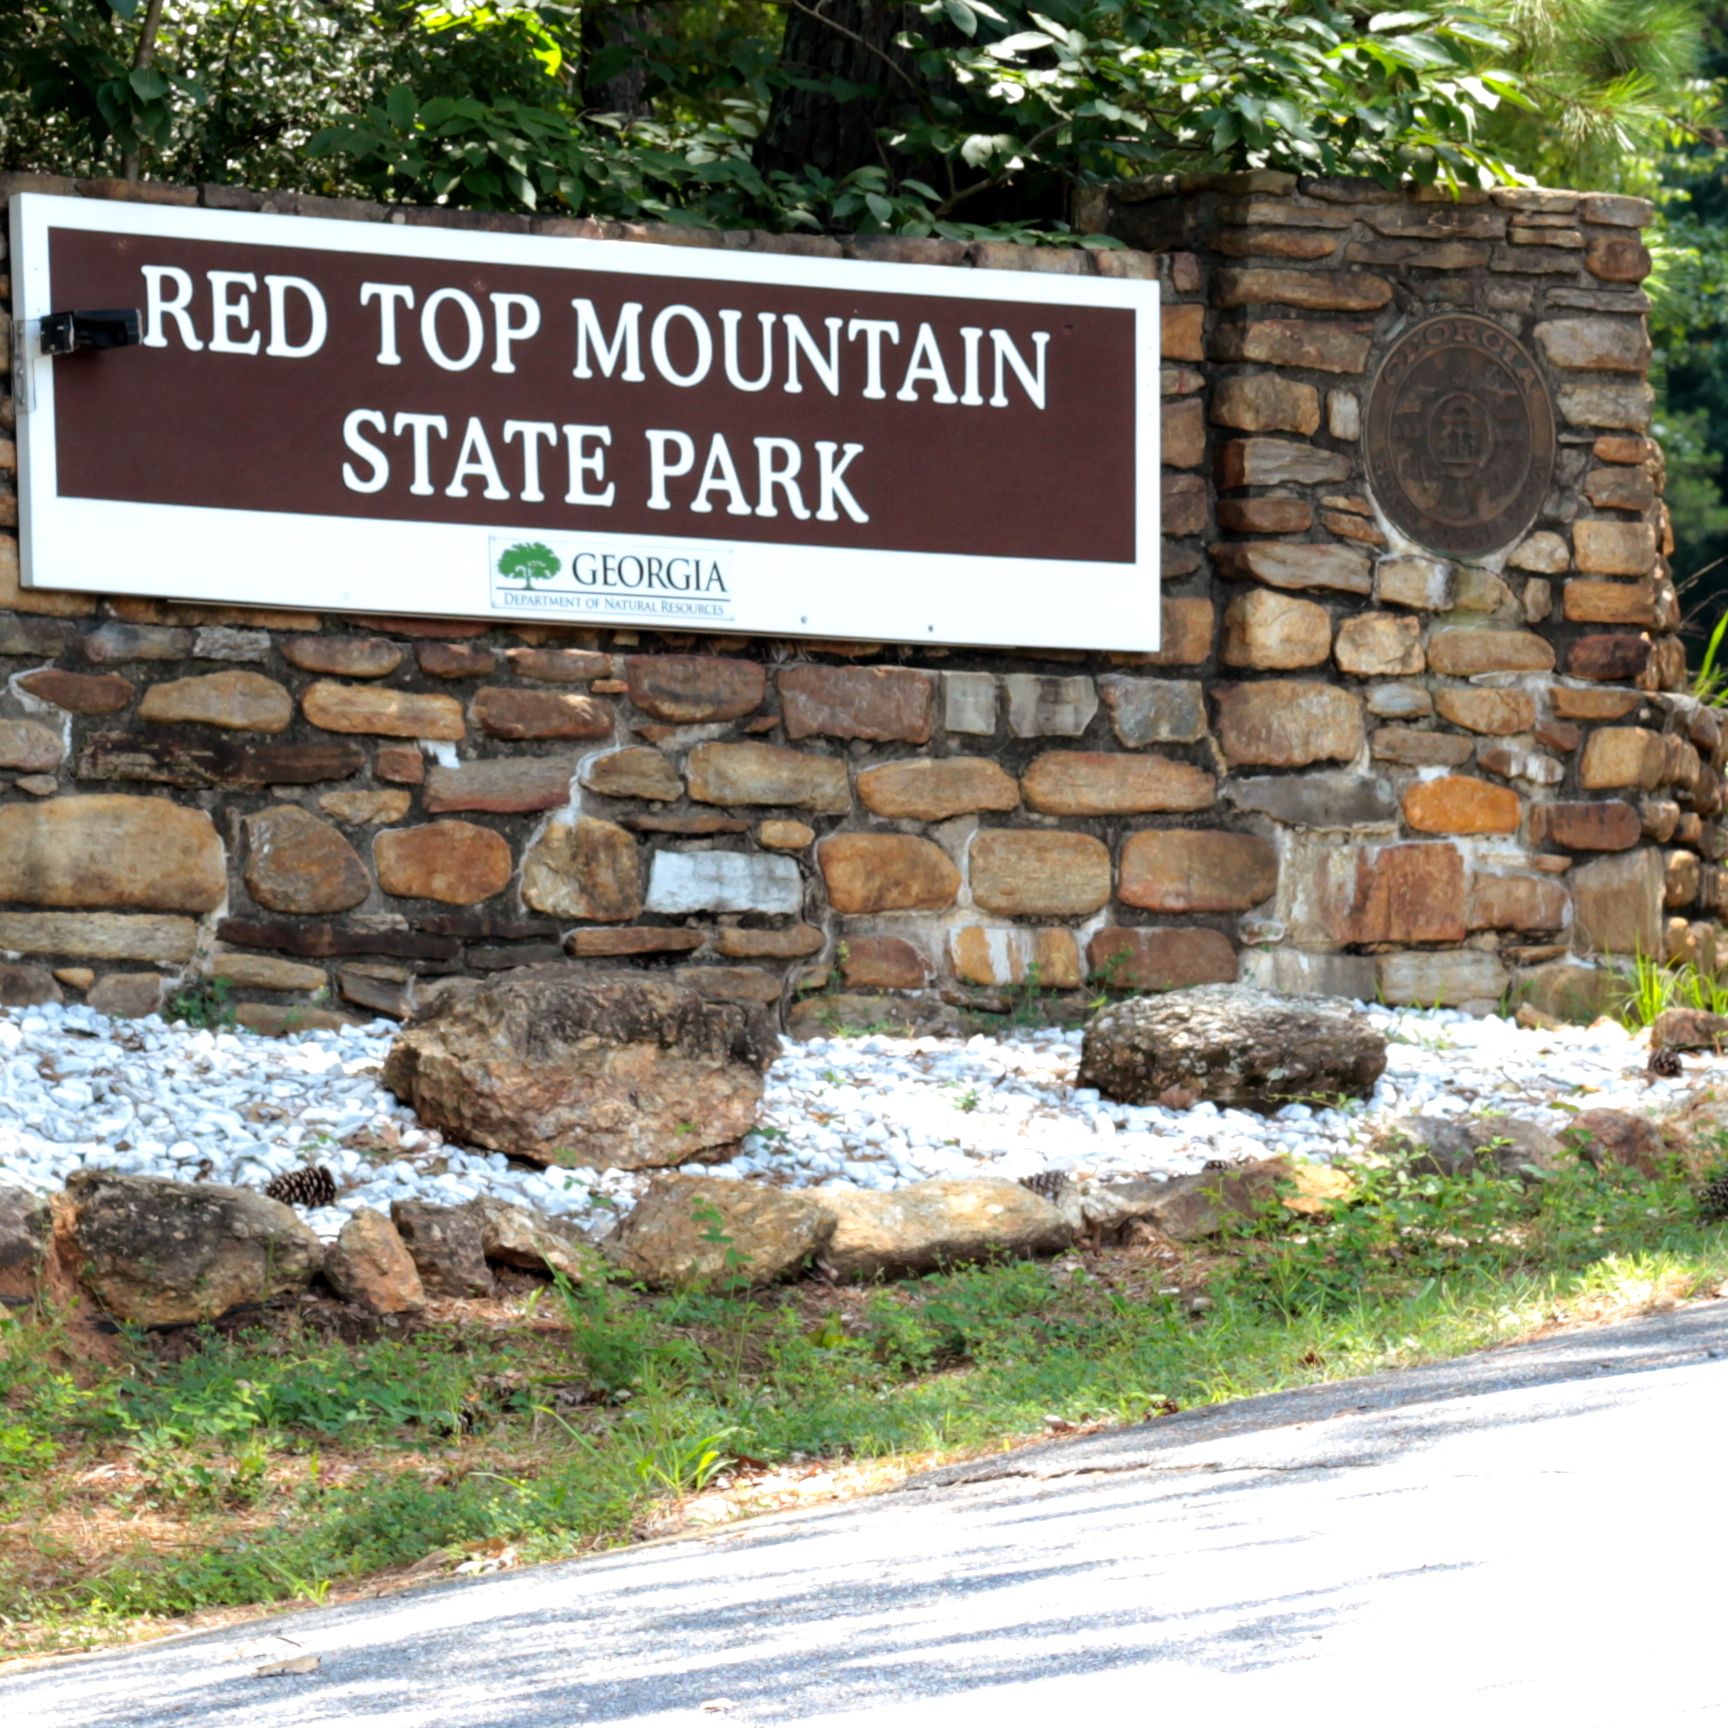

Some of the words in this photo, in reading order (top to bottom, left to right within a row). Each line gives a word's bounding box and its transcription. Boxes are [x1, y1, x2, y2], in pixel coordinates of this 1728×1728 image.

[141, 265, 328, 358] RED
[361, 281, 541, 374] TOP
[571, 298, 1051, 410] MOUNTAIN
[342, 408, 615, 508] STATE
[644, 429, 870, 524] PARK
[503, 592, 582, 609] DEPARTMENT
[604, 597, 658, 612] NATURAL
[660, 599, 725, 616] RESOURCES
[572, 552, 727, 592] GEORGIA
